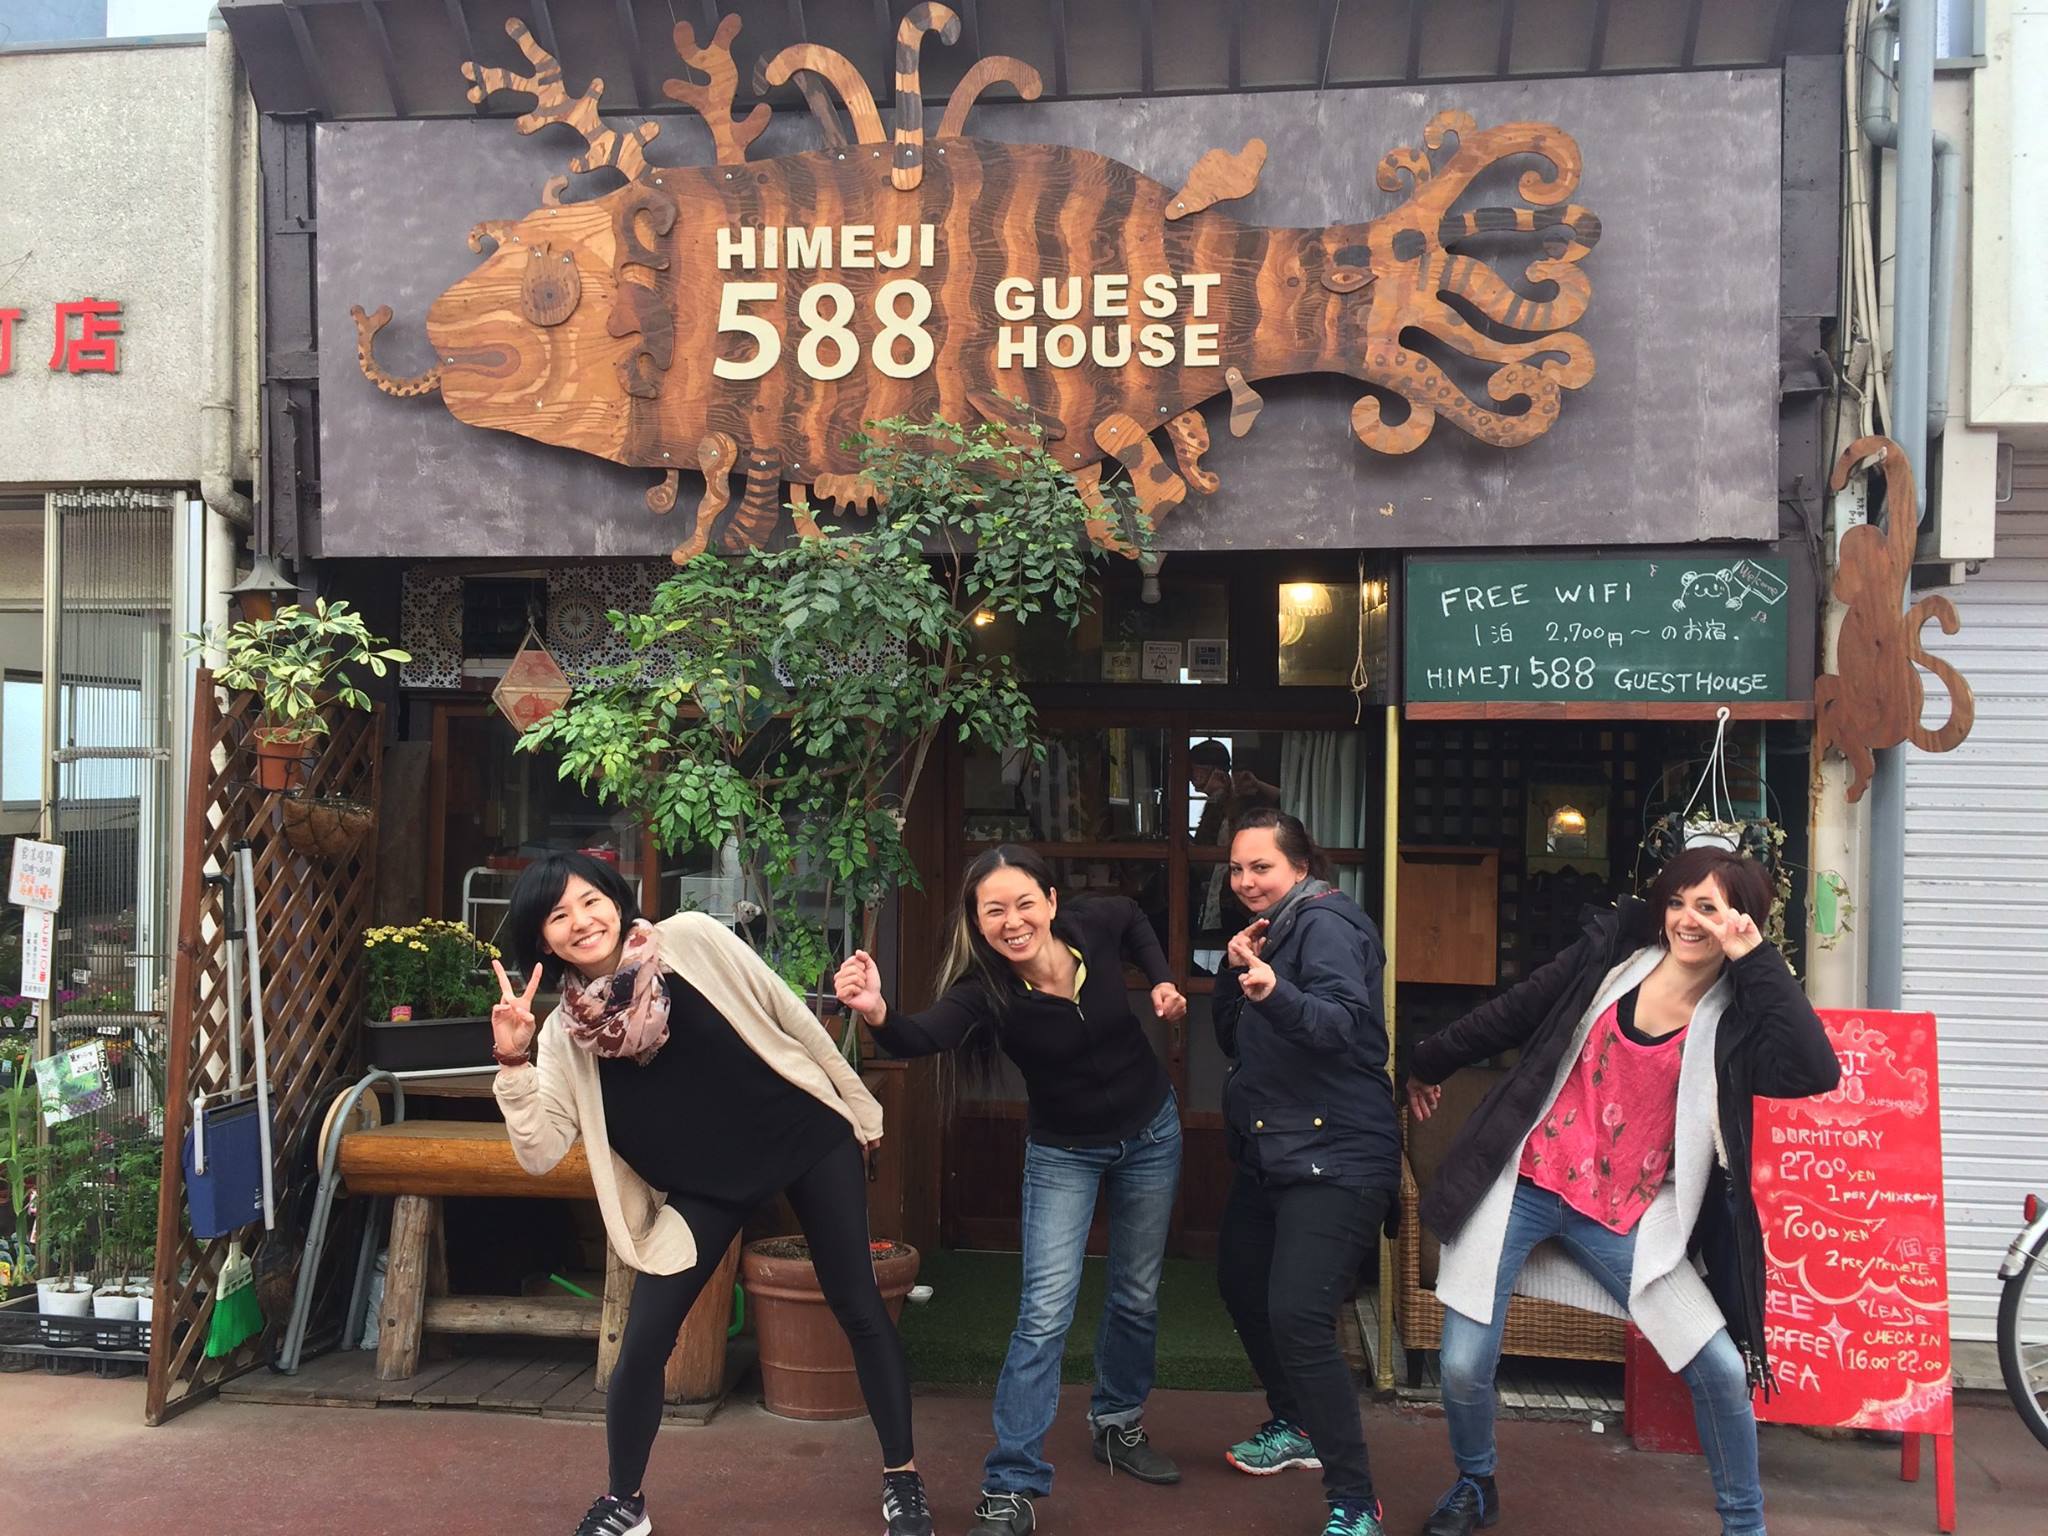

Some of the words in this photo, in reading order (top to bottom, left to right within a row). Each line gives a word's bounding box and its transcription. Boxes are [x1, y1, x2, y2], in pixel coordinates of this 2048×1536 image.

[716, 224, 936, 270] HIMEJI
[993, 273, 1222, 322] GUEST
[712, 279, 936, 381] 588
[998, 323, 1221, 369] HOUSE
[1739, 563, 1780, 597] Welcome
[1440, 583, 1530, 618] FREE
[1555, 582, 1632, 605] WIFI
[1427, 665, 1520, 691] HIMEJI
[1529, 656, 1597, 690] 588
[1771, 1127, 1884, 1150] DORMITORY
[1780, 1151, 1847, 1182] 2700
[1847, 1169, 1876, 1182] YEN
[1783, 1205, 1839, 1239] 7000
[1841, 1229, 1869, 1241] YEN
[1765, 1289, 1815, 1320] REE
[1856, 1298, 1933, 1326] PLEASE
[1764, 1325, 1831, 1358] OFFEE
[1863, 1330, 1915, 1345] CHECK
[1919, 1333, 1941, 1347] IN
